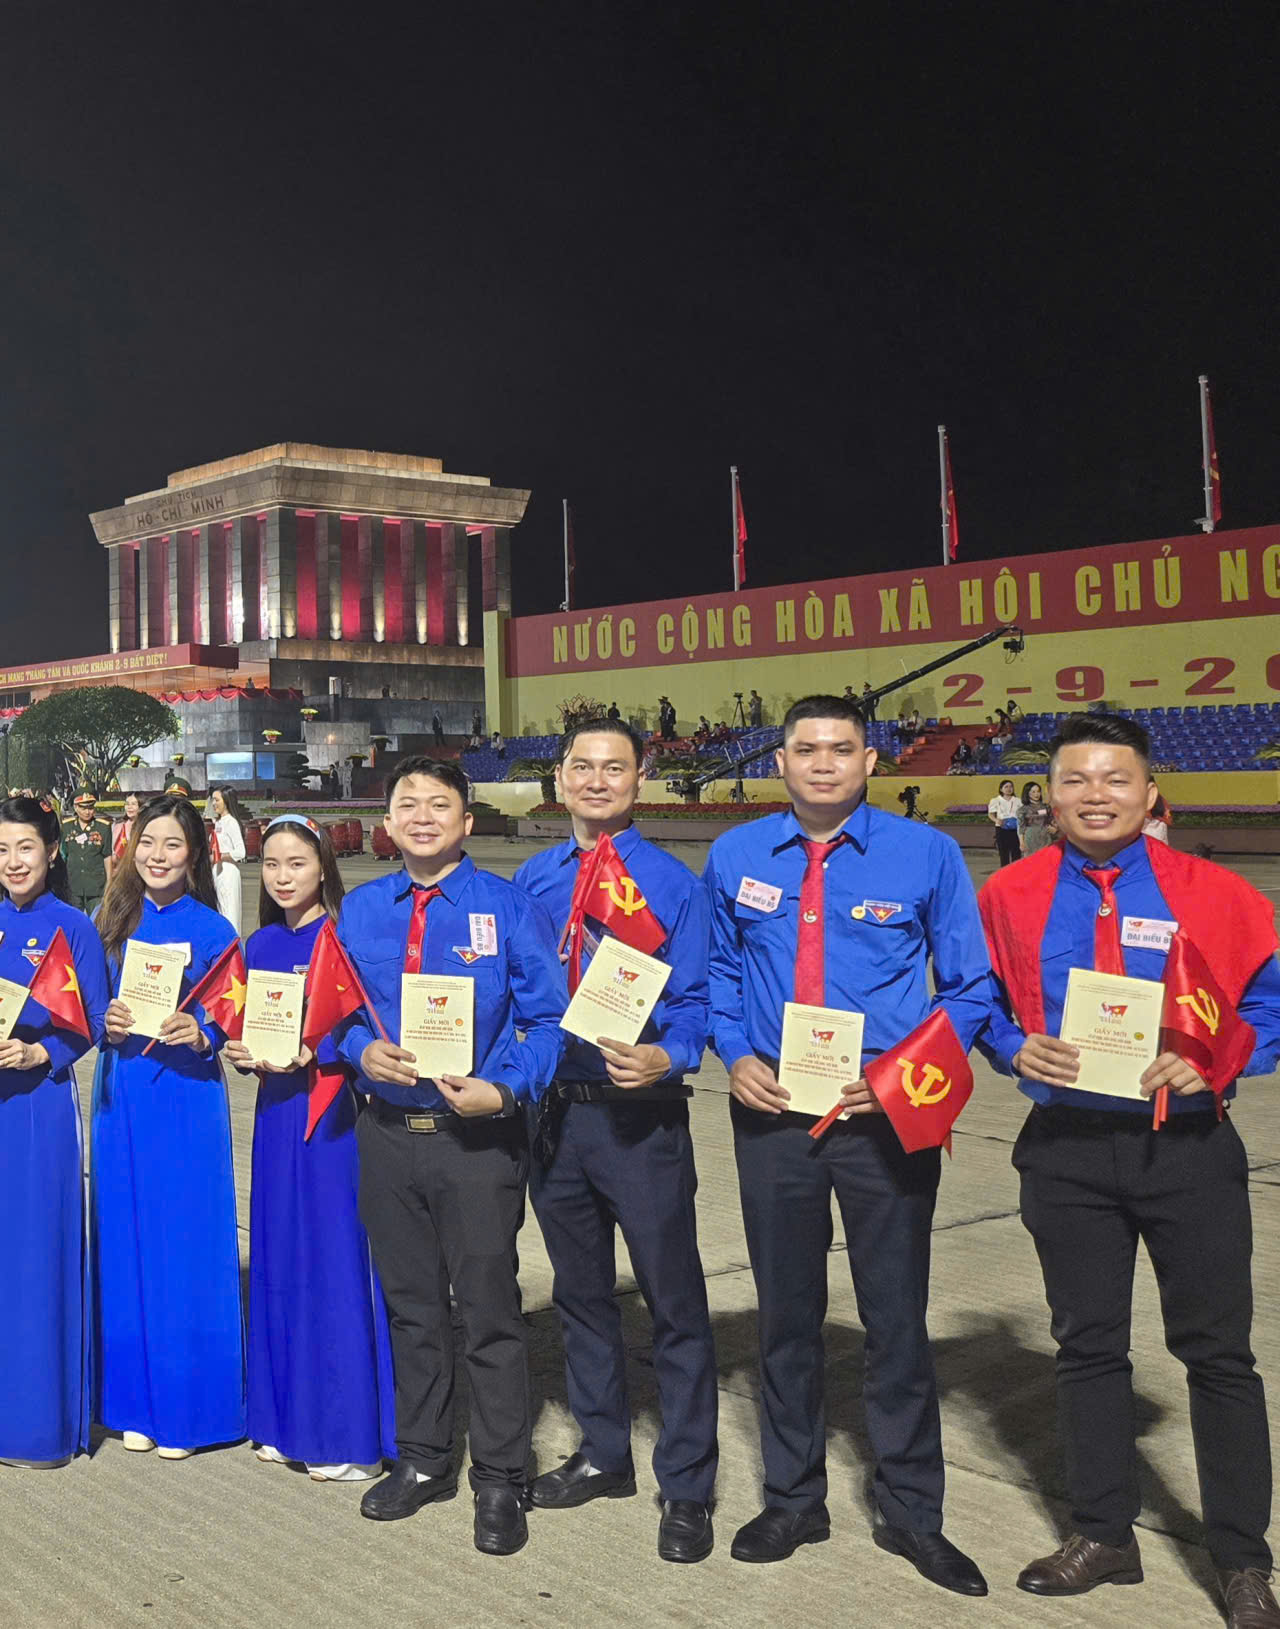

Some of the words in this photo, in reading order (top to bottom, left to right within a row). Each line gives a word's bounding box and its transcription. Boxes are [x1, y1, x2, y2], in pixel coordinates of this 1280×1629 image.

[553, 614, 636, 663] NƯỚC
[657, 604, 752, 659] CỘNG
[776, 590, 855, 642] HÒA
[879, 578, 932, 633] XÃ
[1075, 544, 1181, 616] CHỦ
